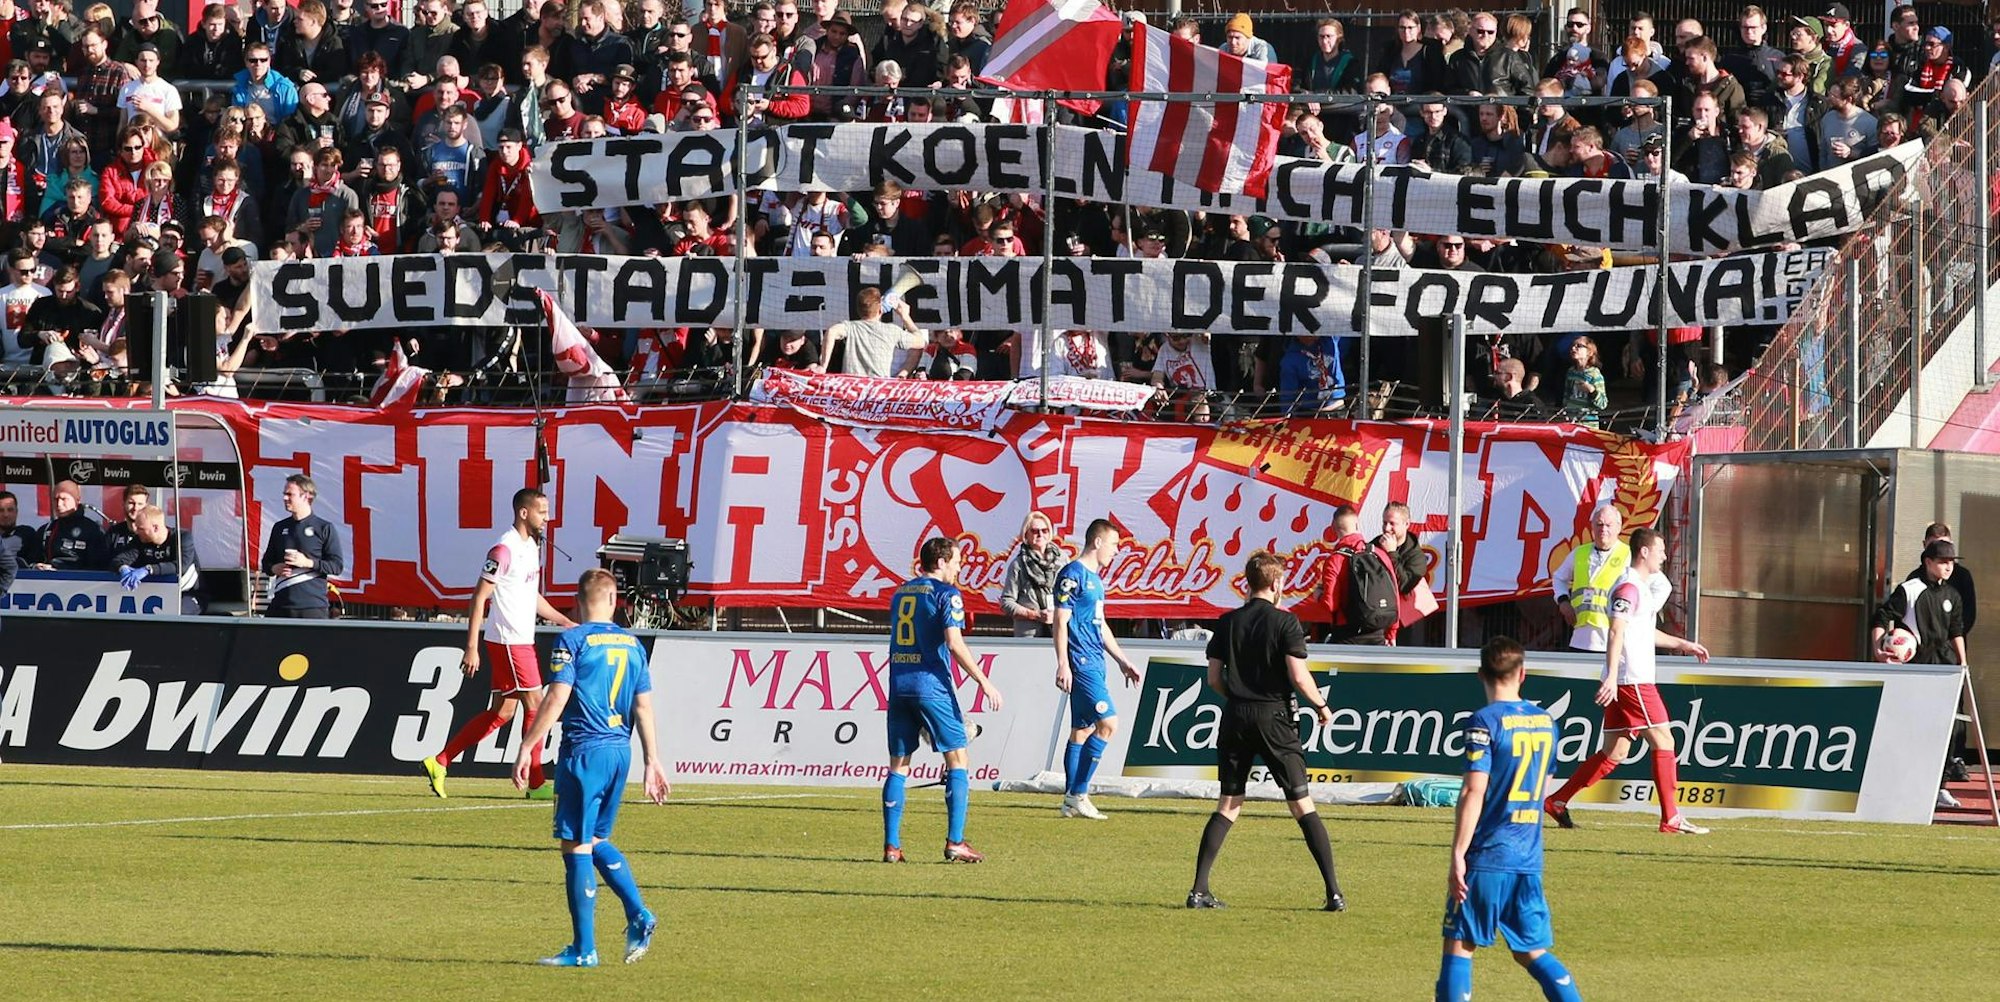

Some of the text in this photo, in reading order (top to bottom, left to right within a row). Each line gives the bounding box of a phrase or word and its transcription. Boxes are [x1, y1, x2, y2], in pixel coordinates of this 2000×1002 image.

[551, 125, 836, 207] STADT
[869, 126, 1127, 200] KOELN
[1161, 158, 1431, 229] CHT
[1457, 176, 1657, 248] EUCH
[847, 259, 1143, 327] HEIMAT
[1172, 261, 1331, 334] DER
[1353, 253, 1779, 333] FORTUNA!
[64, 419, 170, 446] AUTOGLAS
[6, 464, 32, 476] bwin
[104, 467, 131, 478] bwin
[200, 469, 226, 482] bwin
[257, 419, 809, 595] TUNA
[896, 595, 917, 646] 8
[0, 665, 38, 747] A
[58, 650, 371, 758] bwin
[606, 648, 629, 710] 7
[717, 648, 999, 714] MAXM
[710, 718, 983, 745] GRO
[1144, 677, 1470, 758] Kaderma
[1533, 689, 1857, 772] aderma
[1507, 731, 1553, 802] 27
[1619, 784, 1727, 804] SEI 1881
